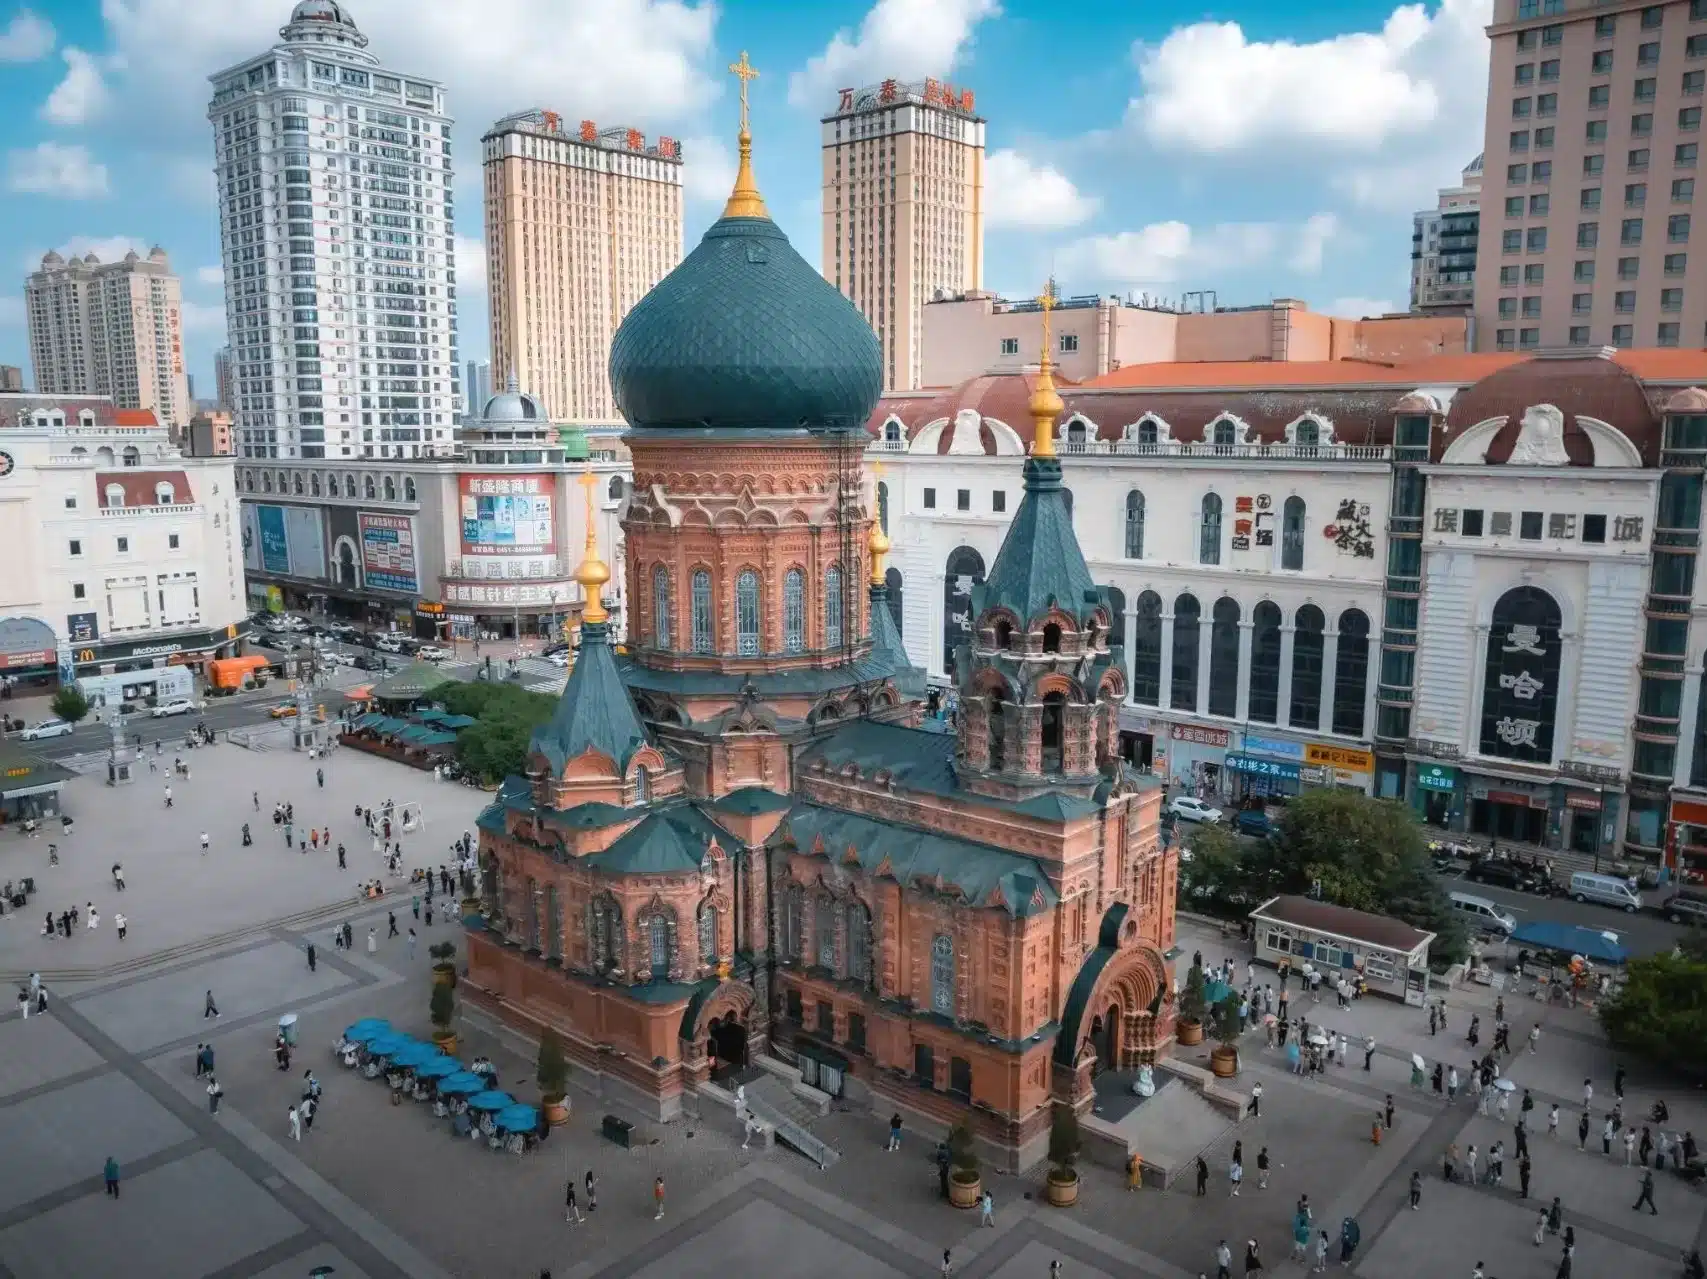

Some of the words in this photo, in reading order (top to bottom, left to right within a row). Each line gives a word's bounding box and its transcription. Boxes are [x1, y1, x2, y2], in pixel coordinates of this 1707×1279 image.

[1496, 624, 1547, 749] 曼哈顿
[1183, 727, 1228, 746] 蜜雪冰城
